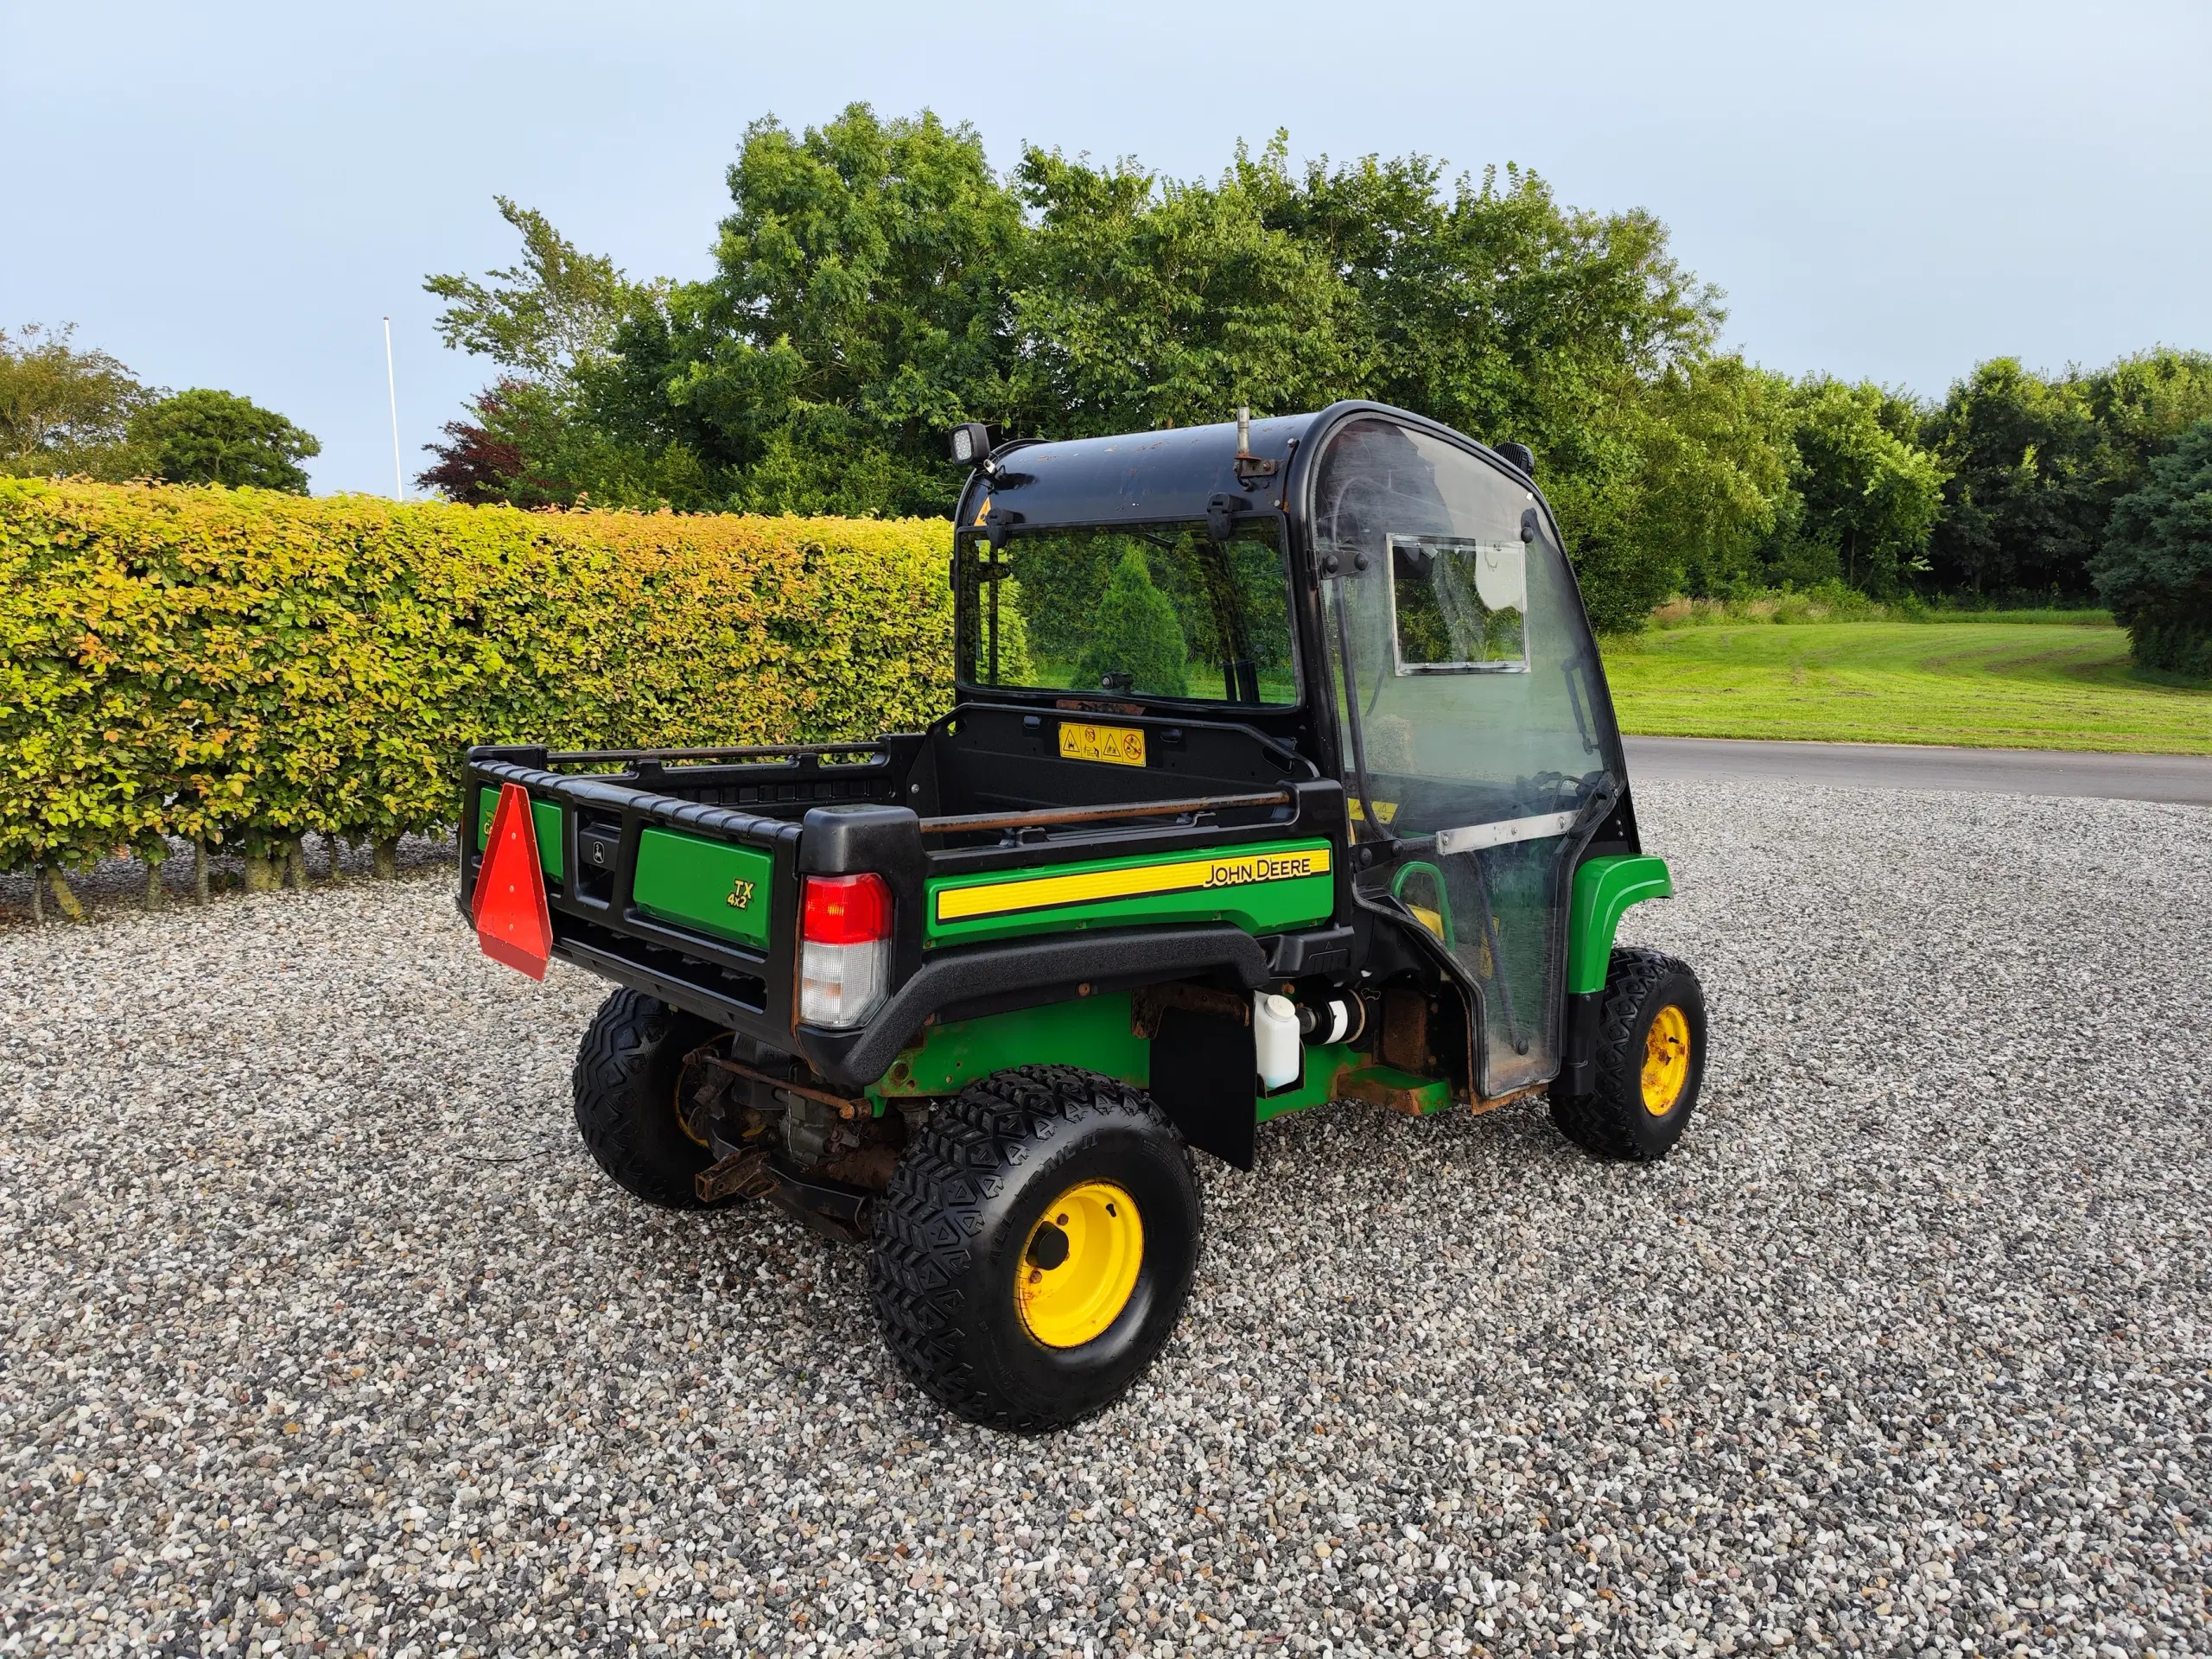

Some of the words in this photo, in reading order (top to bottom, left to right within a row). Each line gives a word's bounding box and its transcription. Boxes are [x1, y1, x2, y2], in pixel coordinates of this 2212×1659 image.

[1205, 864, 1252, 886] JOHN
[1257, 858, 1311, 879] DEERE
[727, 893, 747, 909] 4x2
[734, 879, 754, 899] TX
[988, 1214, 1016, 1266] ALL
[1014, 1145, 1077, 1203] TRAIL
